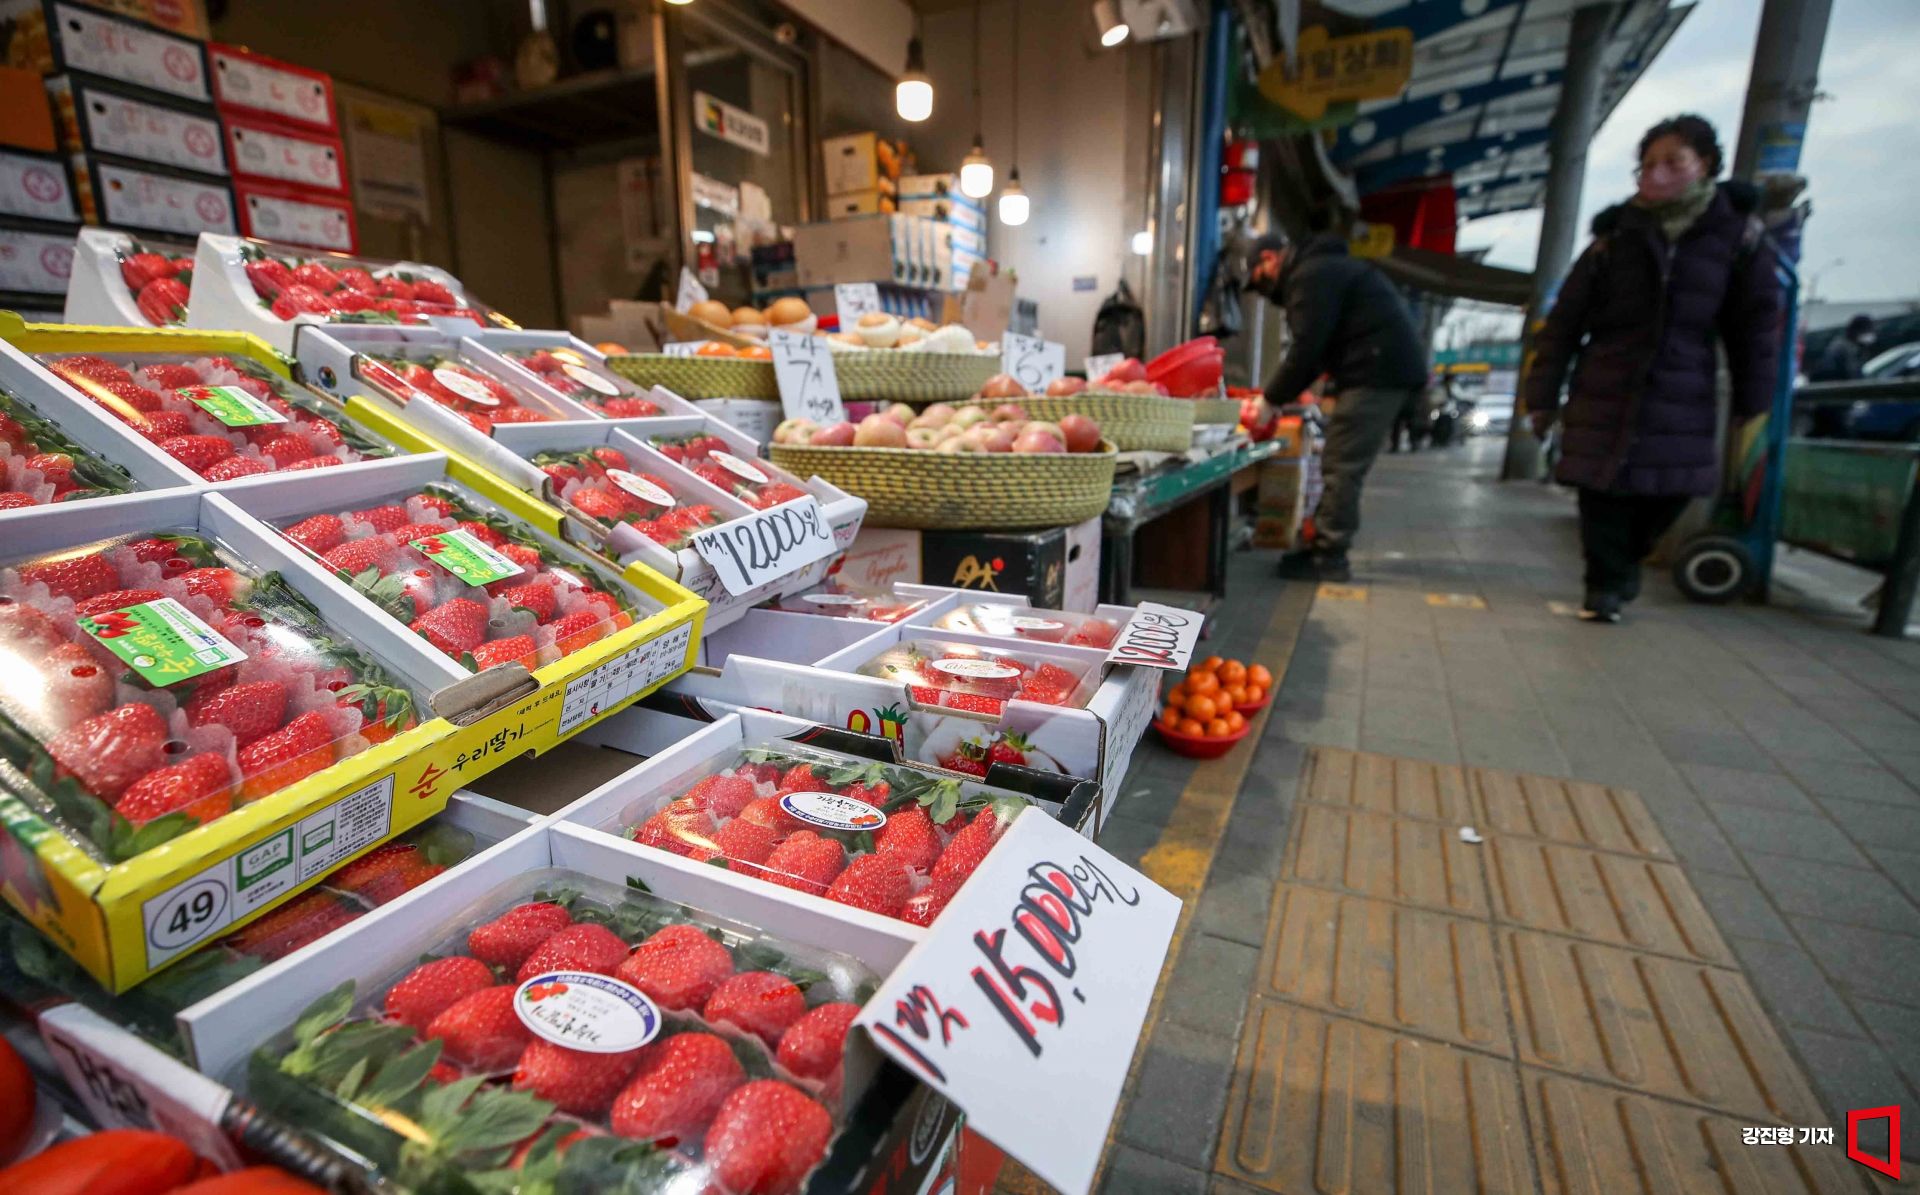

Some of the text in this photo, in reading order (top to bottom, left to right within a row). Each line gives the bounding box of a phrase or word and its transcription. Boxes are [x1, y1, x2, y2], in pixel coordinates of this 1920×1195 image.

[408, 762, 448, 800] 순
[450, 722, 524, 772] 우리딸기
[249, 842, 282, 866] GAP
[167, 888, 214, 935] 49
